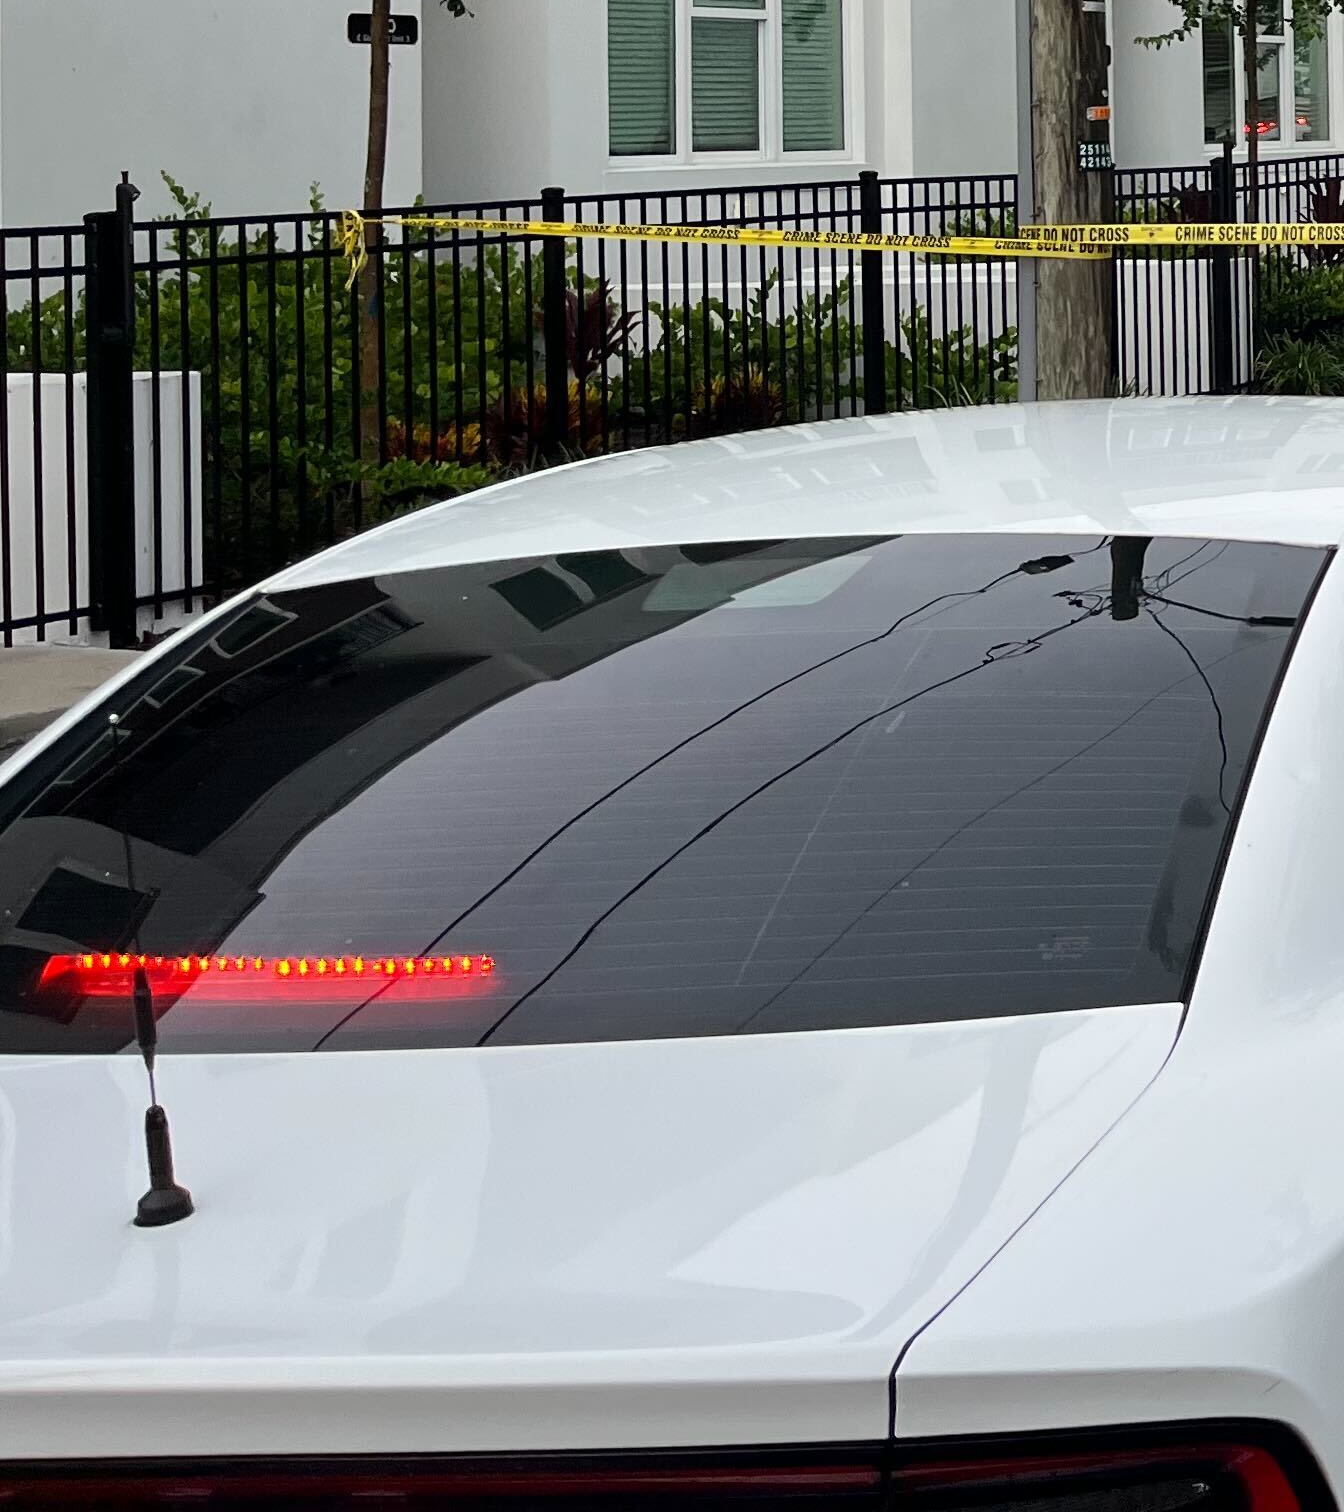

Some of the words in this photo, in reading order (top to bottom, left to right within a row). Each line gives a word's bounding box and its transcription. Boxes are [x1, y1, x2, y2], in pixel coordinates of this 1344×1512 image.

[783, 231, 821, 243] CRIME
[824, 232, 862, 245] SCENE
[866, 233, 882, 246] DO
[885, 234, 908, 247] NOT
[912, 235, 951, 248] CROSS
[1018, 227, 1041, 240] CENE
[1044, 228, 1058, 242] DO
[1061, 227, 1086, 242] NOT
[1089, 227, 1129, 242] CROSS
[1175, 226, 1214, 241] CRIME
[1218, 226, 1256, 241] SCENE
[1261, 226, 1277, 241] DO
[1282, 225, 1304, 241] NOT
